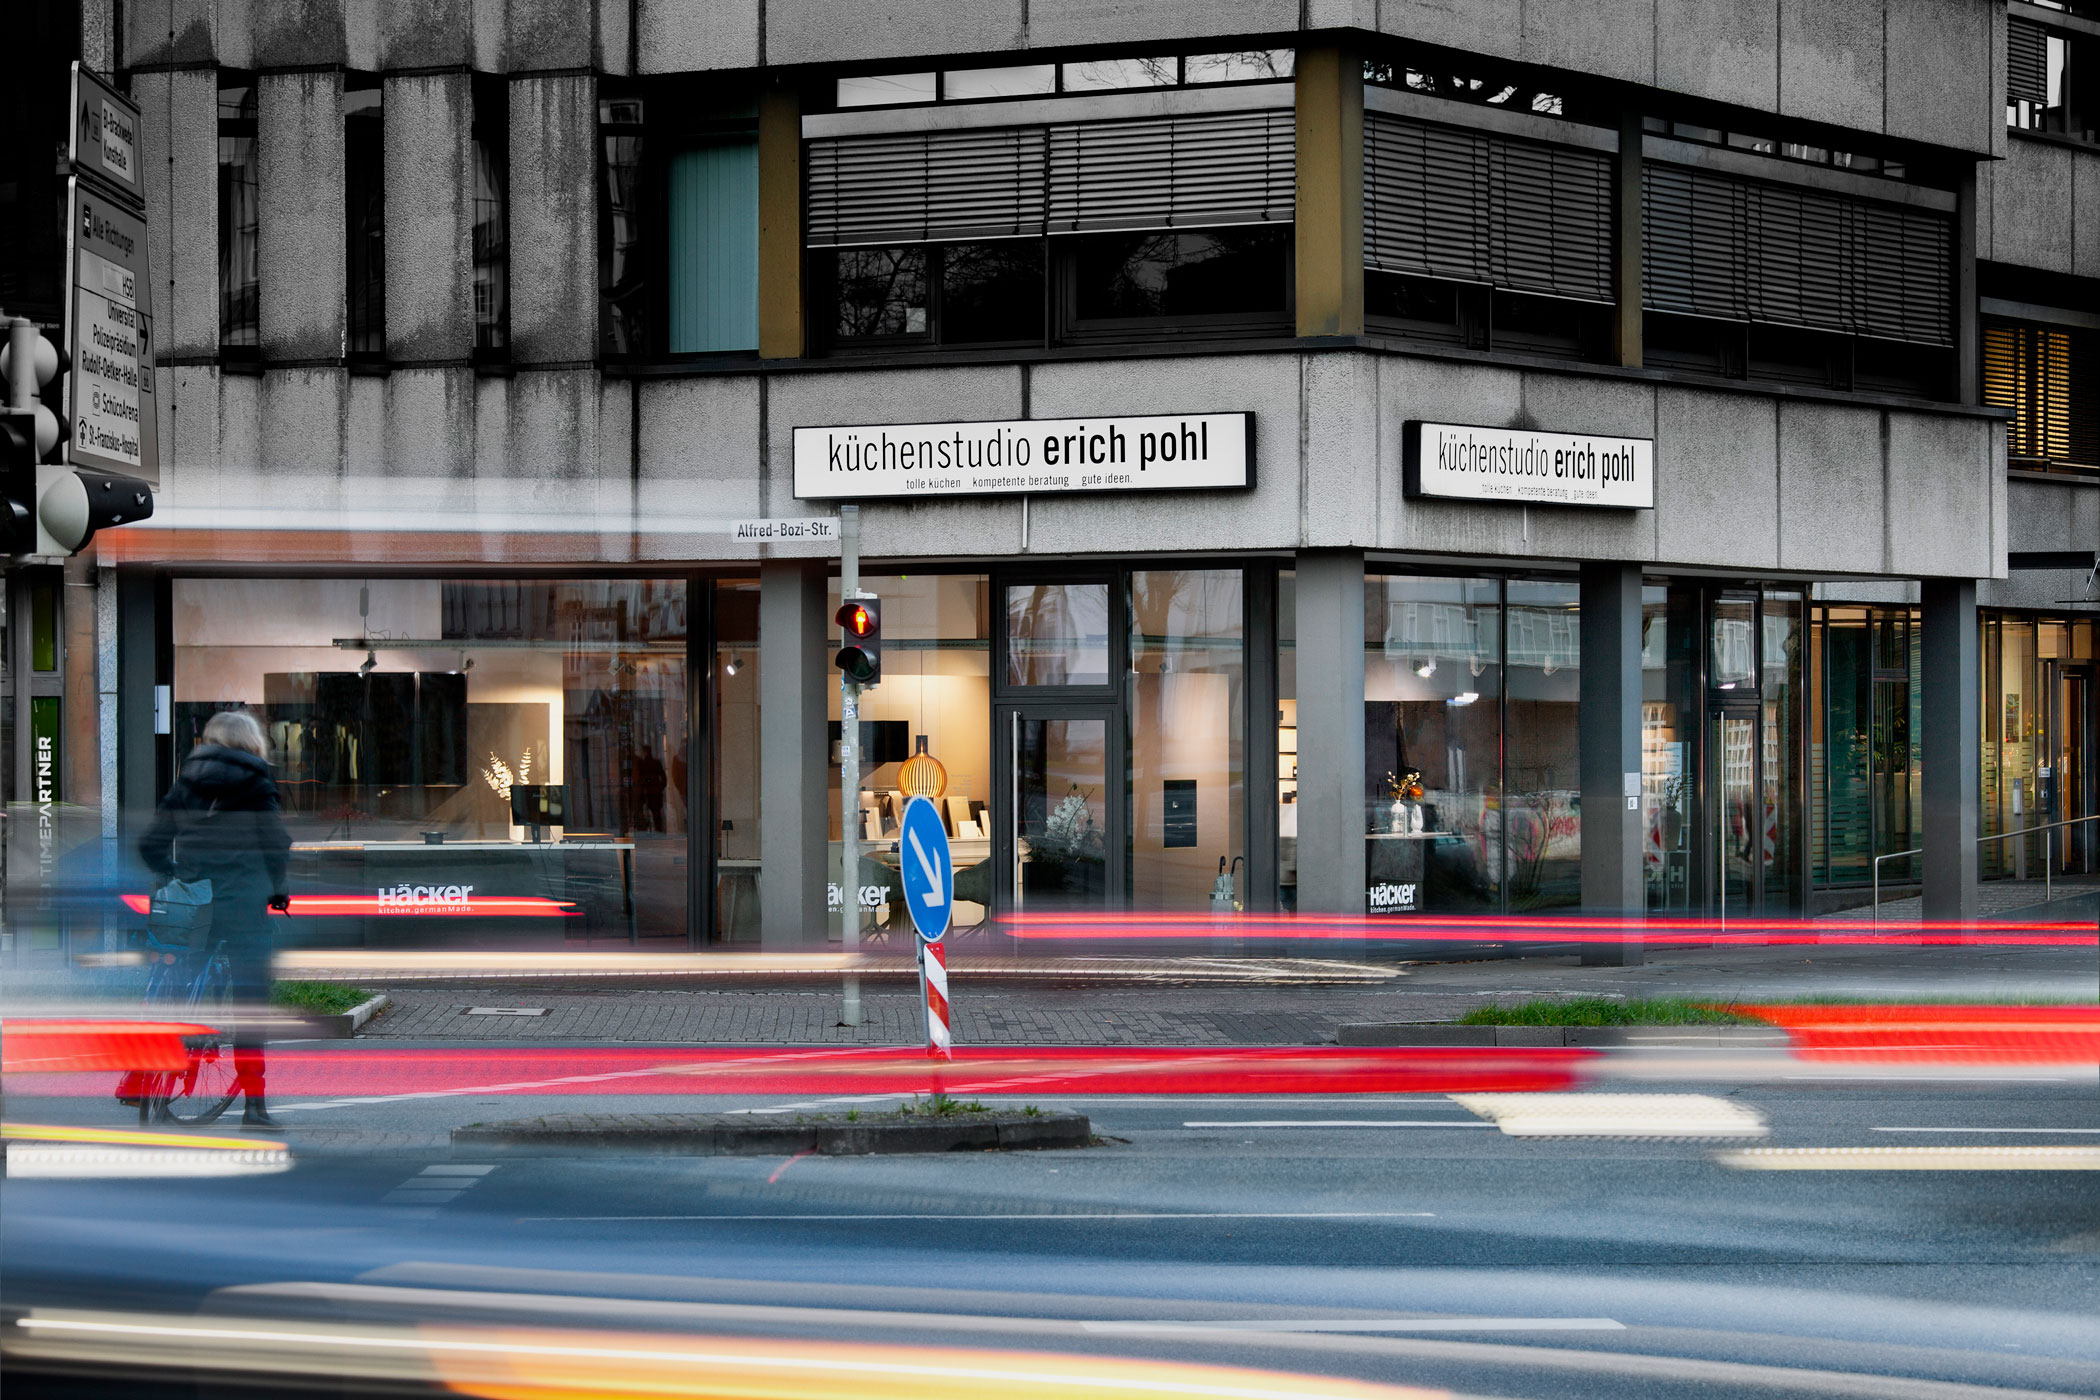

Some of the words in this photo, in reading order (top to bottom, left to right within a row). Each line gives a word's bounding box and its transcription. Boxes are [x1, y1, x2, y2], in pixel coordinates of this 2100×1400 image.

[93, 323, 136, 358] Polizeipräsidium
[82, 350, 137, 388] Rudolf-Oetker-Halle
[103, 393, 138, 422] SchücoArena
[829, 428, 1031, 472] küchenstudio
[1043, 425, 1126, 465] erich
[1140, 422, 1208, 471] pohl
[1439, 431, 1549, 477] küchenstudio
[1554, 441, 1596, 480] erich
[1602, 444, 1635, 489] pohl
[929, 477, 961, 488] küchen
[1029, 475, 1070, 487] beratung
[1105, 472, 1133, 484] ideen.
[738, 522, 832, 537] Alfred-Bozi-Str.
[38, 736, 52, 877] TIMEPARTNER
